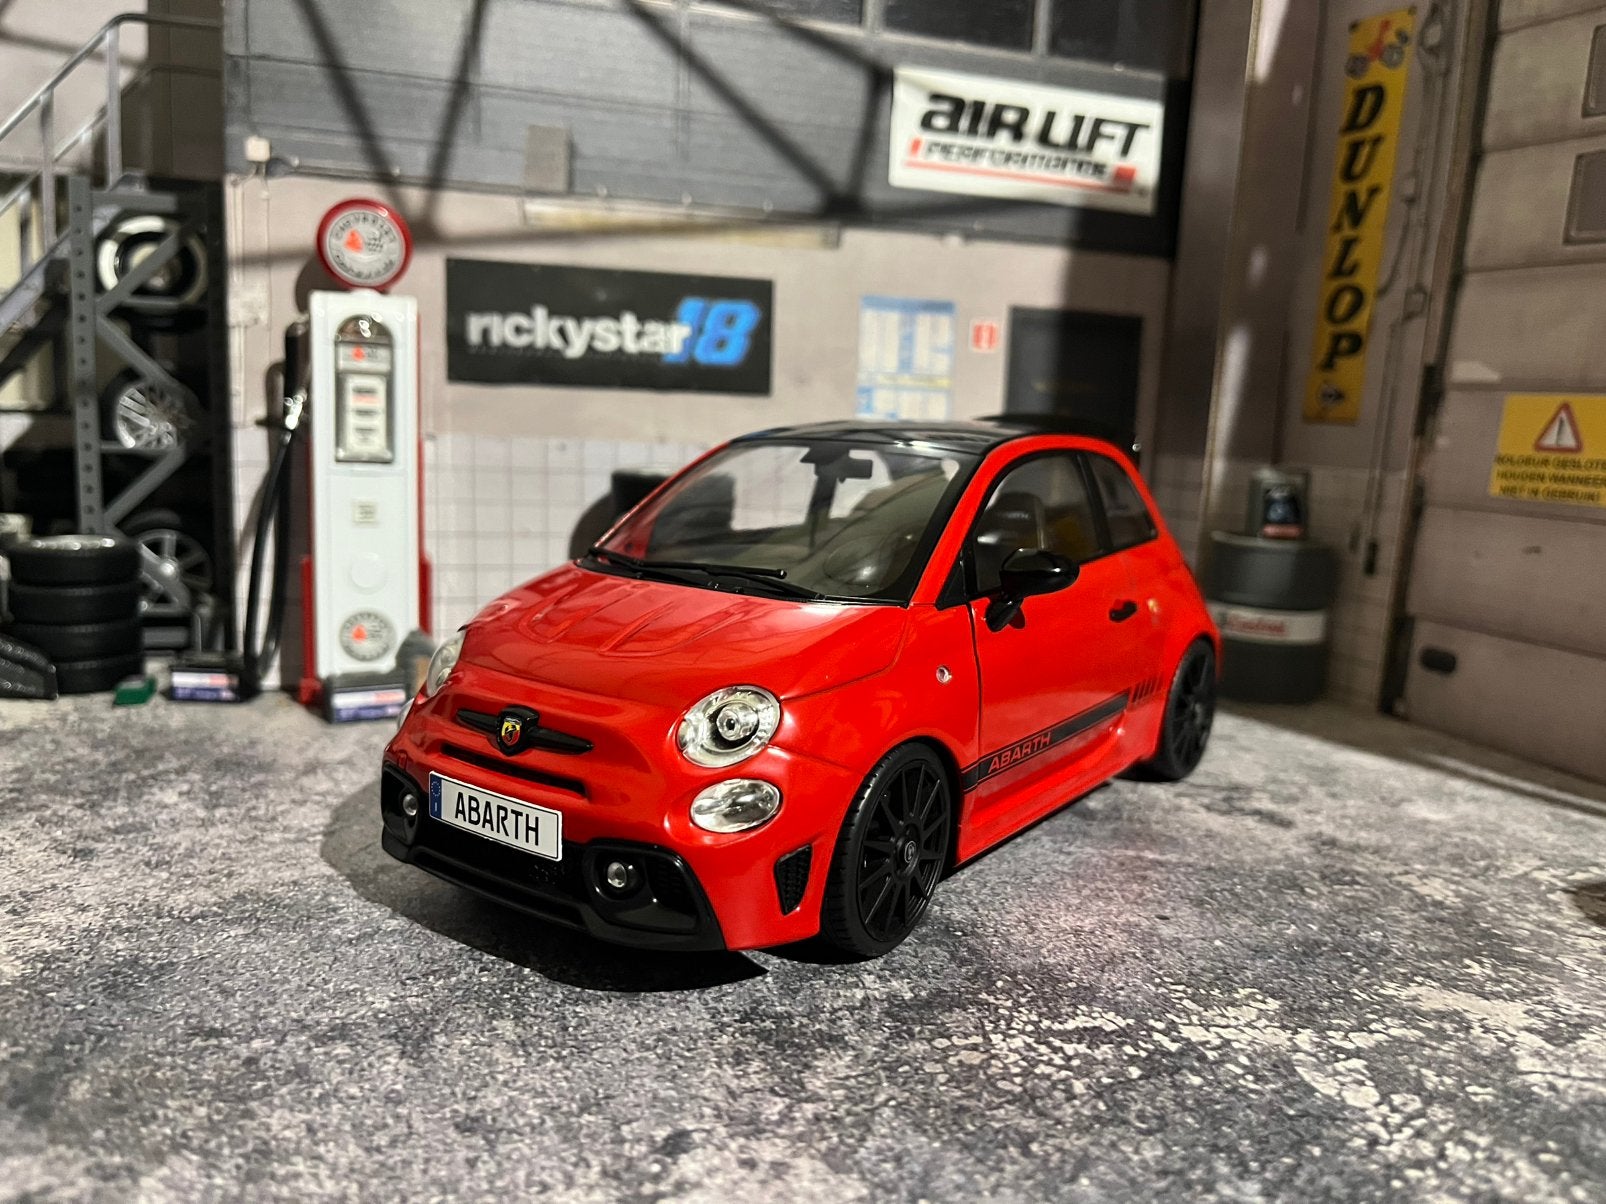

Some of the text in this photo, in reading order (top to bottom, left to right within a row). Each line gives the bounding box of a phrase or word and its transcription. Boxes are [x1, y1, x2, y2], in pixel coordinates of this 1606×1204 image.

[1320, 83, 1385, 373] DUNLOP
[987, 731, 1051, 773] ABARTH
[454, 791, 539, 846] ABARTH
